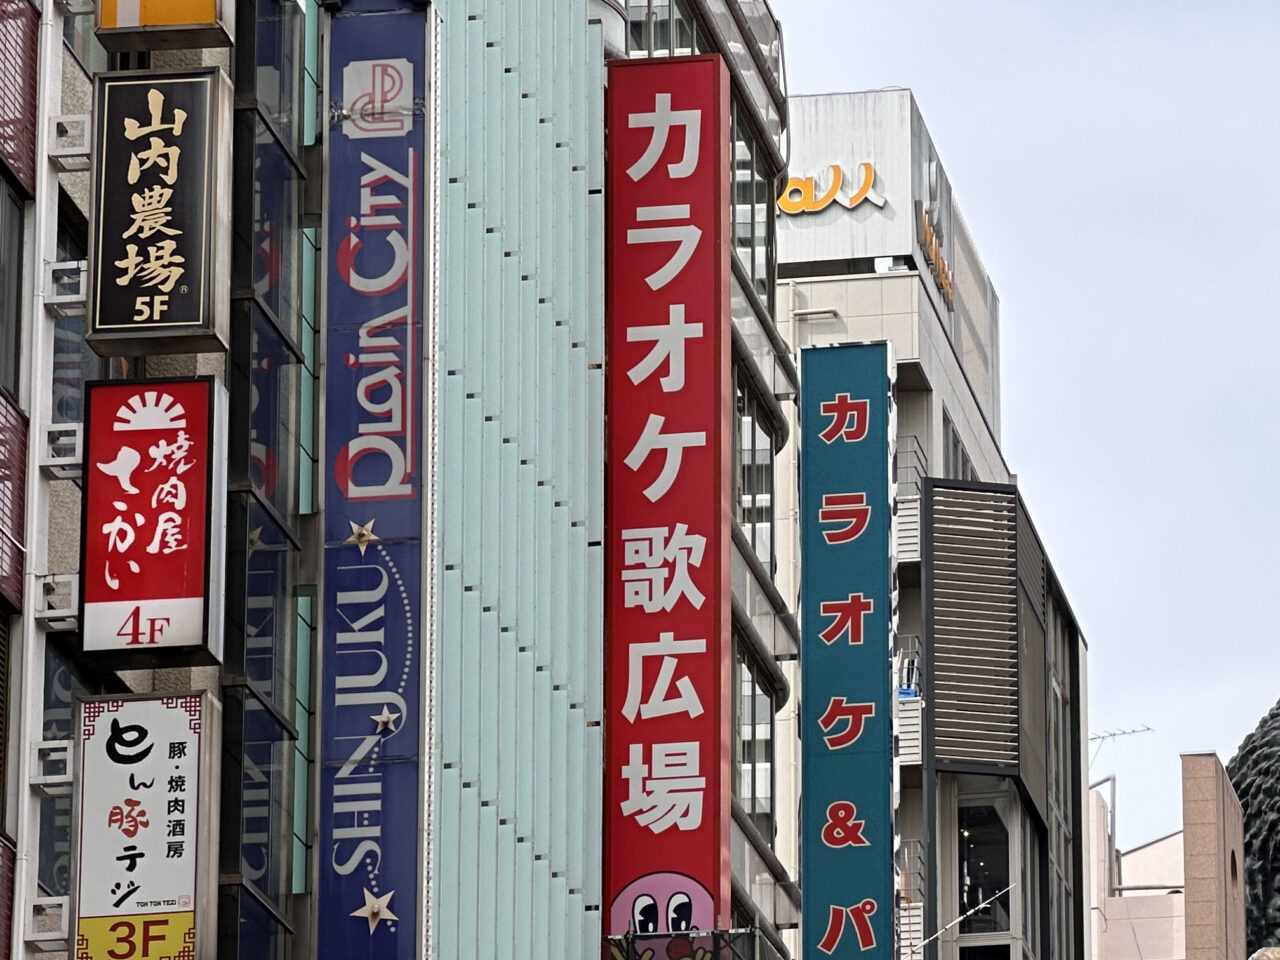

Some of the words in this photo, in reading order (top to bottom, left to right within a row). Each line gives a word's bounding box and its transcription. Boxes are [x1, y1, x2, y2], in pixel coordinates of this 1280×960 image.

[115, 89, 187, 292] 山内農場
[133, 296, 169, 322] 5F
[97, 445, 145, 590] さかい
[146, 431, 197, 554] 焼肉屋
[622, 92, 706, 834] カラオケ歌広場
[116, 607, 170, 646] 4F
[333, 563, 407, 876] SHINJUKU
[167, 741, 188, 859] 豚・焼肉酒房
[107, 919, 169, 960] 3F
